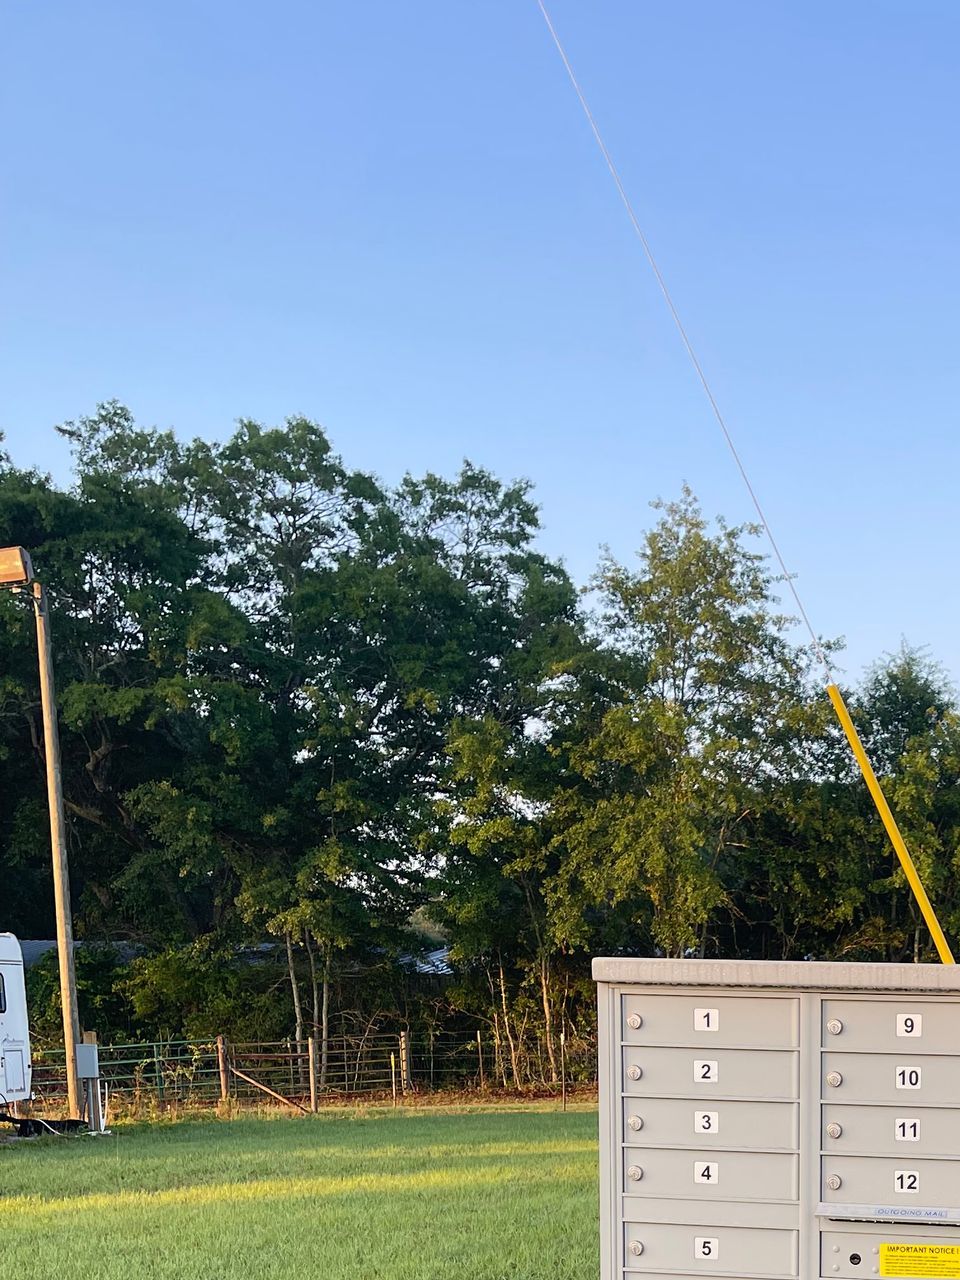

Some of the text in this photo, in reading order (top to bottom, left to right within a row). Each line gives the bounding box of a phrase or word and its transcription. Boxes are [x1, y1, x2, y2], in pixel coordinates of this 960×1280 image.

[703, 1013, 710, 1027] 1
[904, 1018, 915, 1033] 9
[701, 1064, 711, 1079] 2
[898, 1071, 918, 1086] 10
[702, 1115, 712, 1129] 3
[898, 1123, 917, 1137] 11
[701, 1166, 712, 1180] 4
[896, 1175, 916, 1189] 12
[878, 1208, 922, 1216] OUTGOING
[702, 1241, 712, 1255] 5
[887, 1246, 927, 1254] IMPORTANT
[929, 1247, 955, 1255] NOTICE
